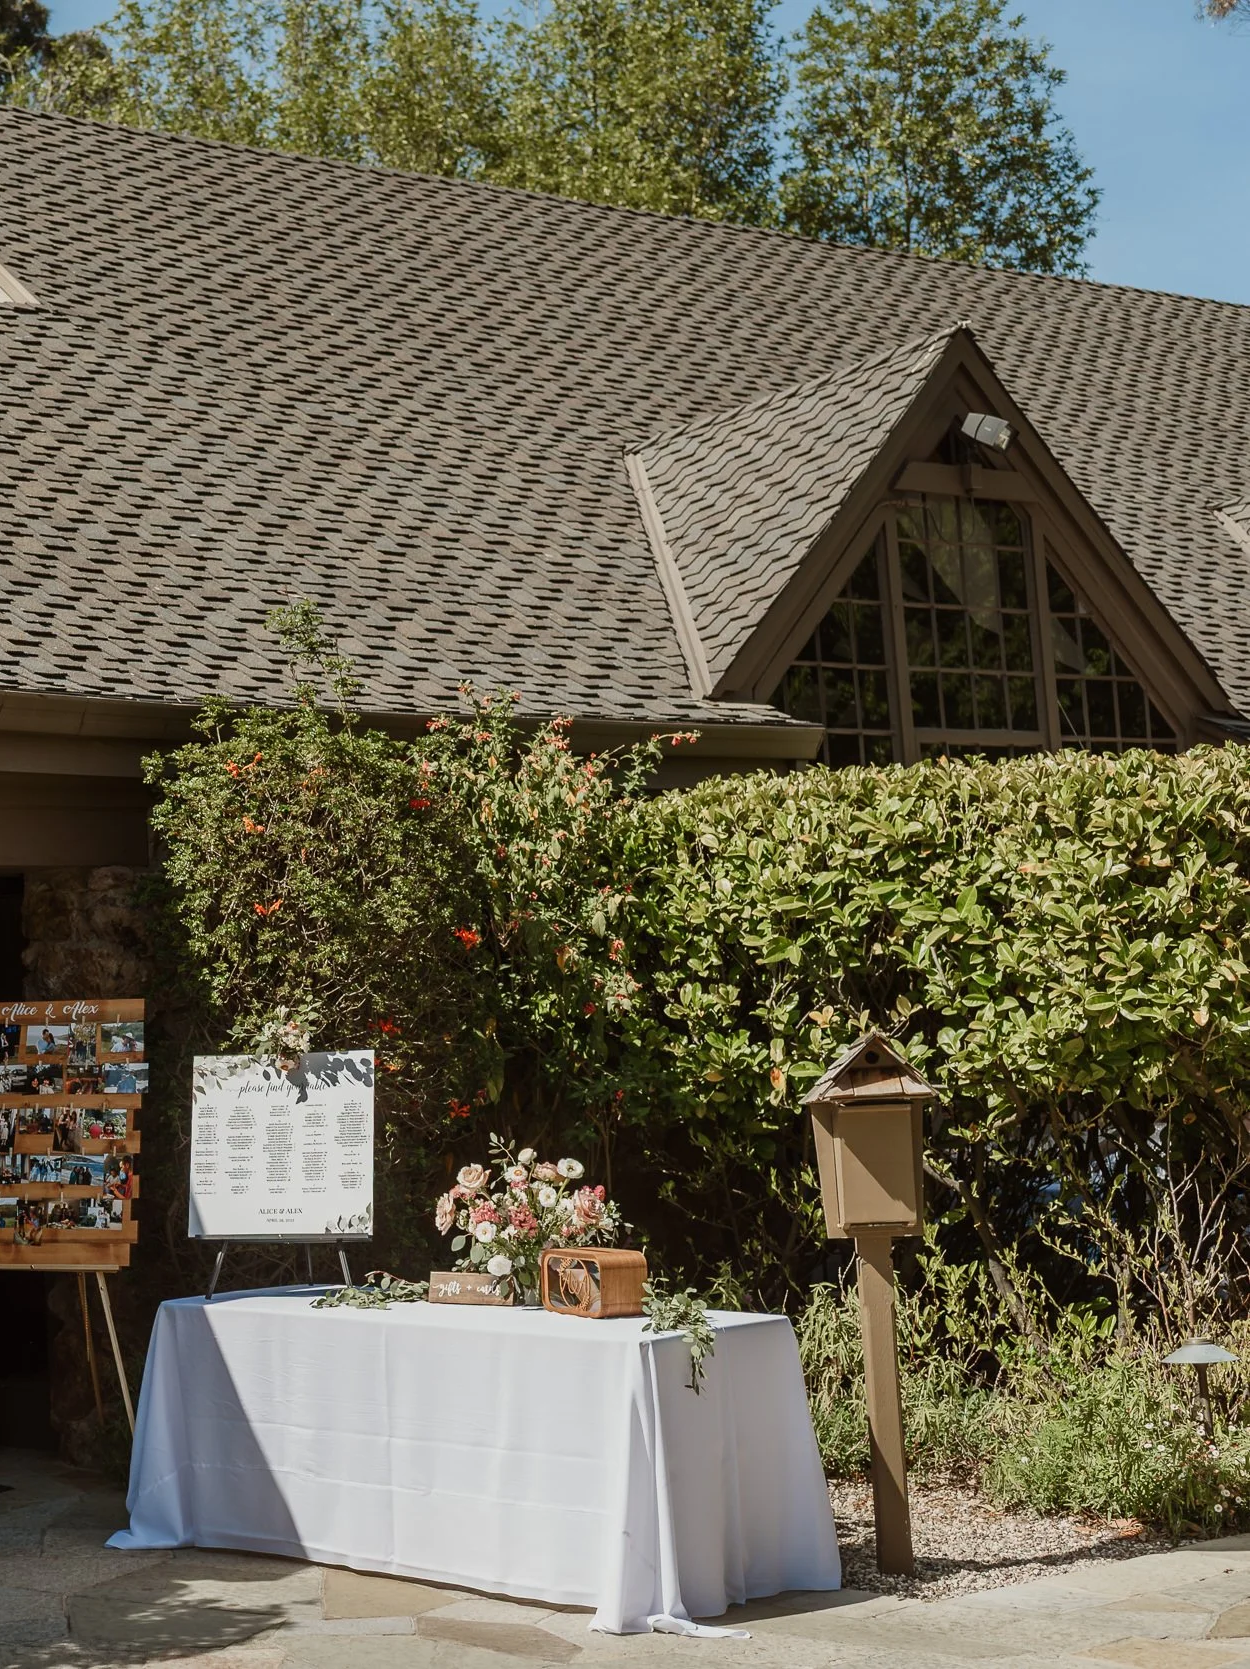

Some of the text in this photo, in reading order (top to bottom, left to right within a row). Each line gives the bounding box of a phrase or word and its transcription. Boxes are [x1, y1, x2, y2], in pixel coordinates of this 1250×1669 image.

[1, 1001, 99, 1022] Alice & Alex
[238, 1080, 264, 1099] please
[265, 1079, 285, 1097] find
[432, 1280, 461, 1297] gifts
[476, 1279, 501, 1296] cards
